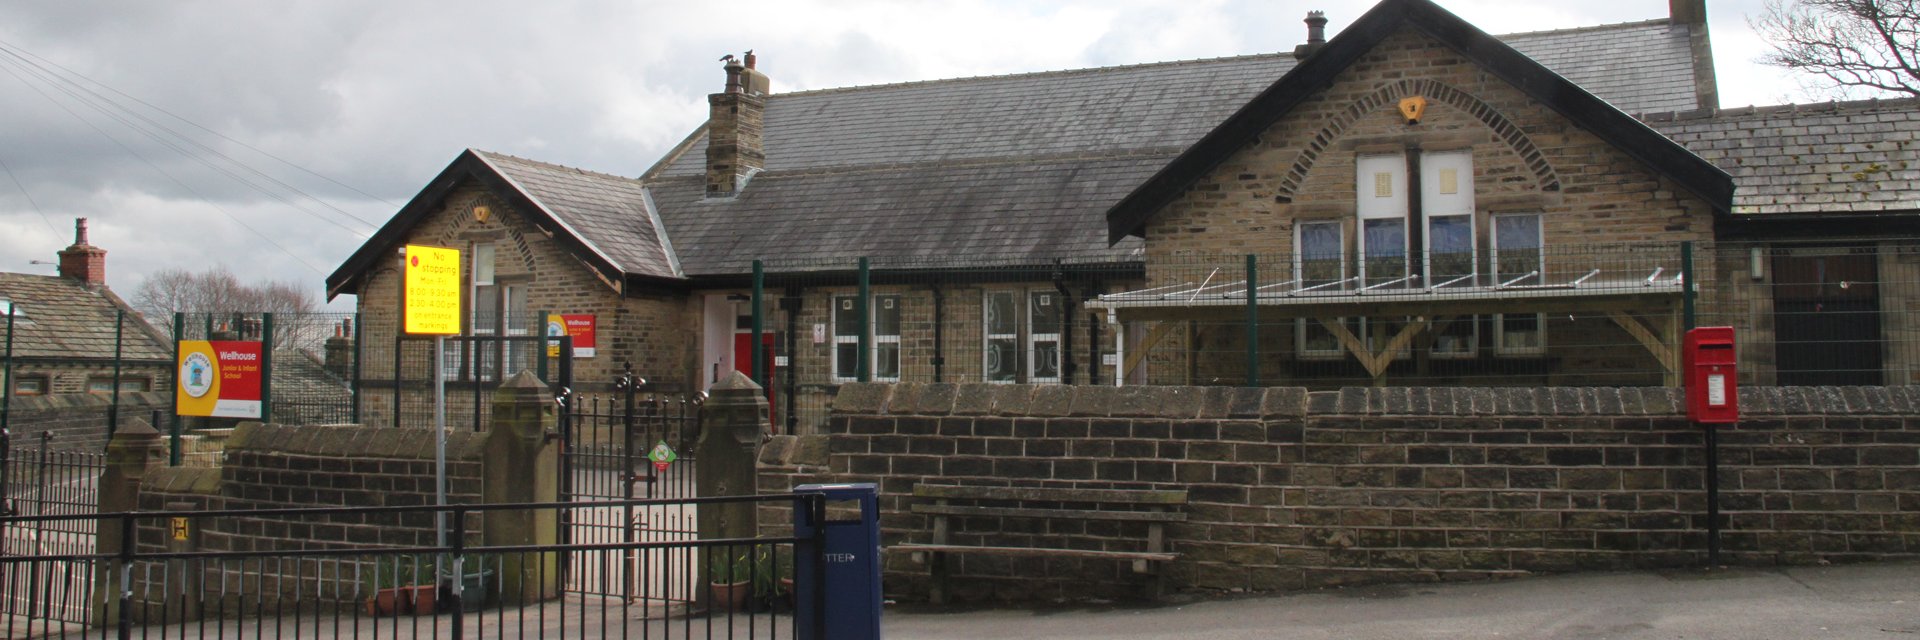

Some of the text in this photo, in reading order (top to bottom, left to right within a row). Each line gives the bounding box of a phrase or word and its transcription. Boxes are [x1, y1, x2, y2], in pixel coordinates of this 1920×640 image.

[434, 252, 445, 261] No
[422, 264, 457, 276] stopping
[219, 351, 257, 361] Wellhouse
[223, 371, 242, 379] School
[825, 553, 854, 562] TTER
